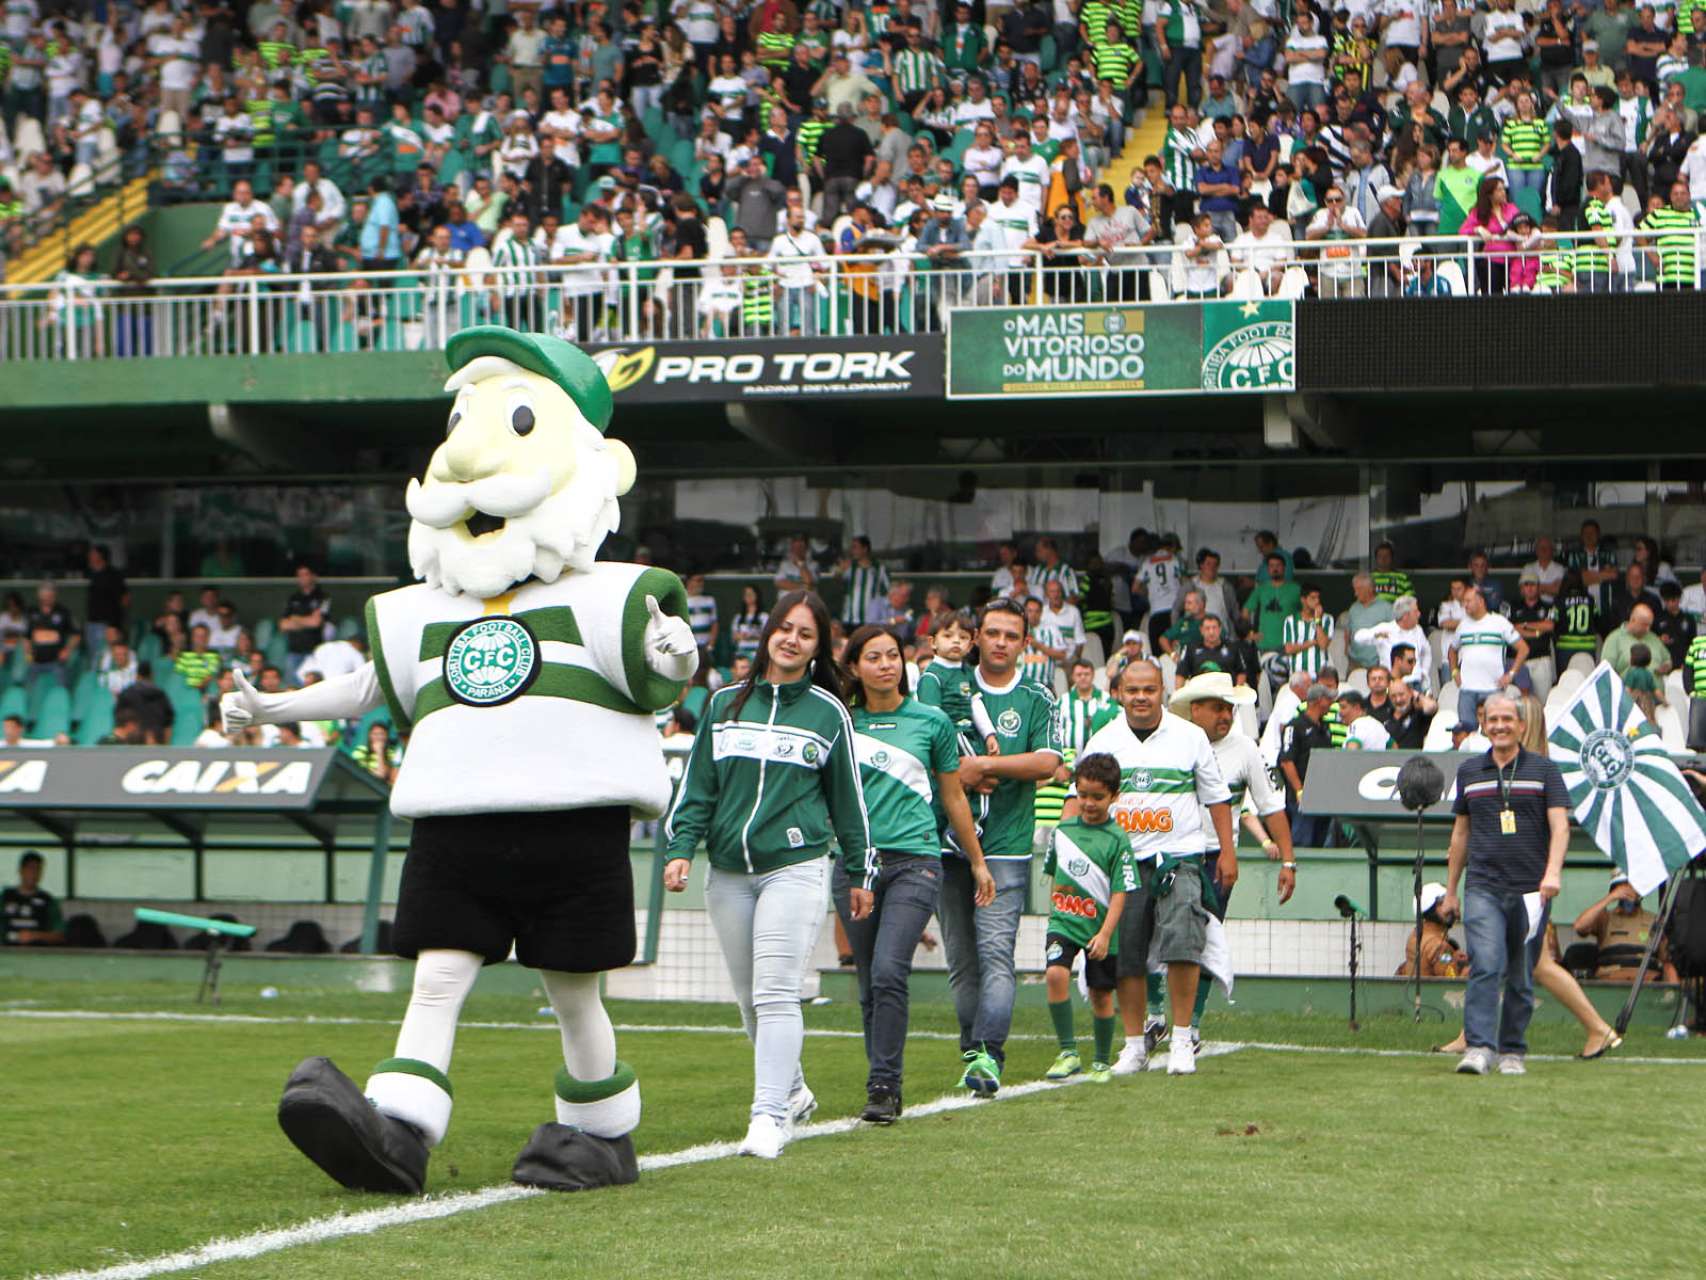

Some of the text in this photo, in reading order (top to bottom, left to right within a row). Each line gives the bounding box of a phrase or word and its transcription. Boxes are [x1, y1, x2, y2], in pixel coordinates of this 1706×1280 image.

[1003, 313, 1083, 336] O MAIS
[1004, 333, 1145, 358] VITORIOSO
[654, 351, 915, 383] PRO TORK
[1003, 354, 1145, 382] DO MUNDO
[801, 381, 912, 393] DEVELOPMENT
[1155, 563, 1167, 586] 9
[1566, 604, 1590, 633] 10
[464, 647, 515, 671] CFC
[121, 760, 312, 793] CAIXA
[1115, 806, 1173, 832] BMG
[1052, 892, 1097, 918] BMG
